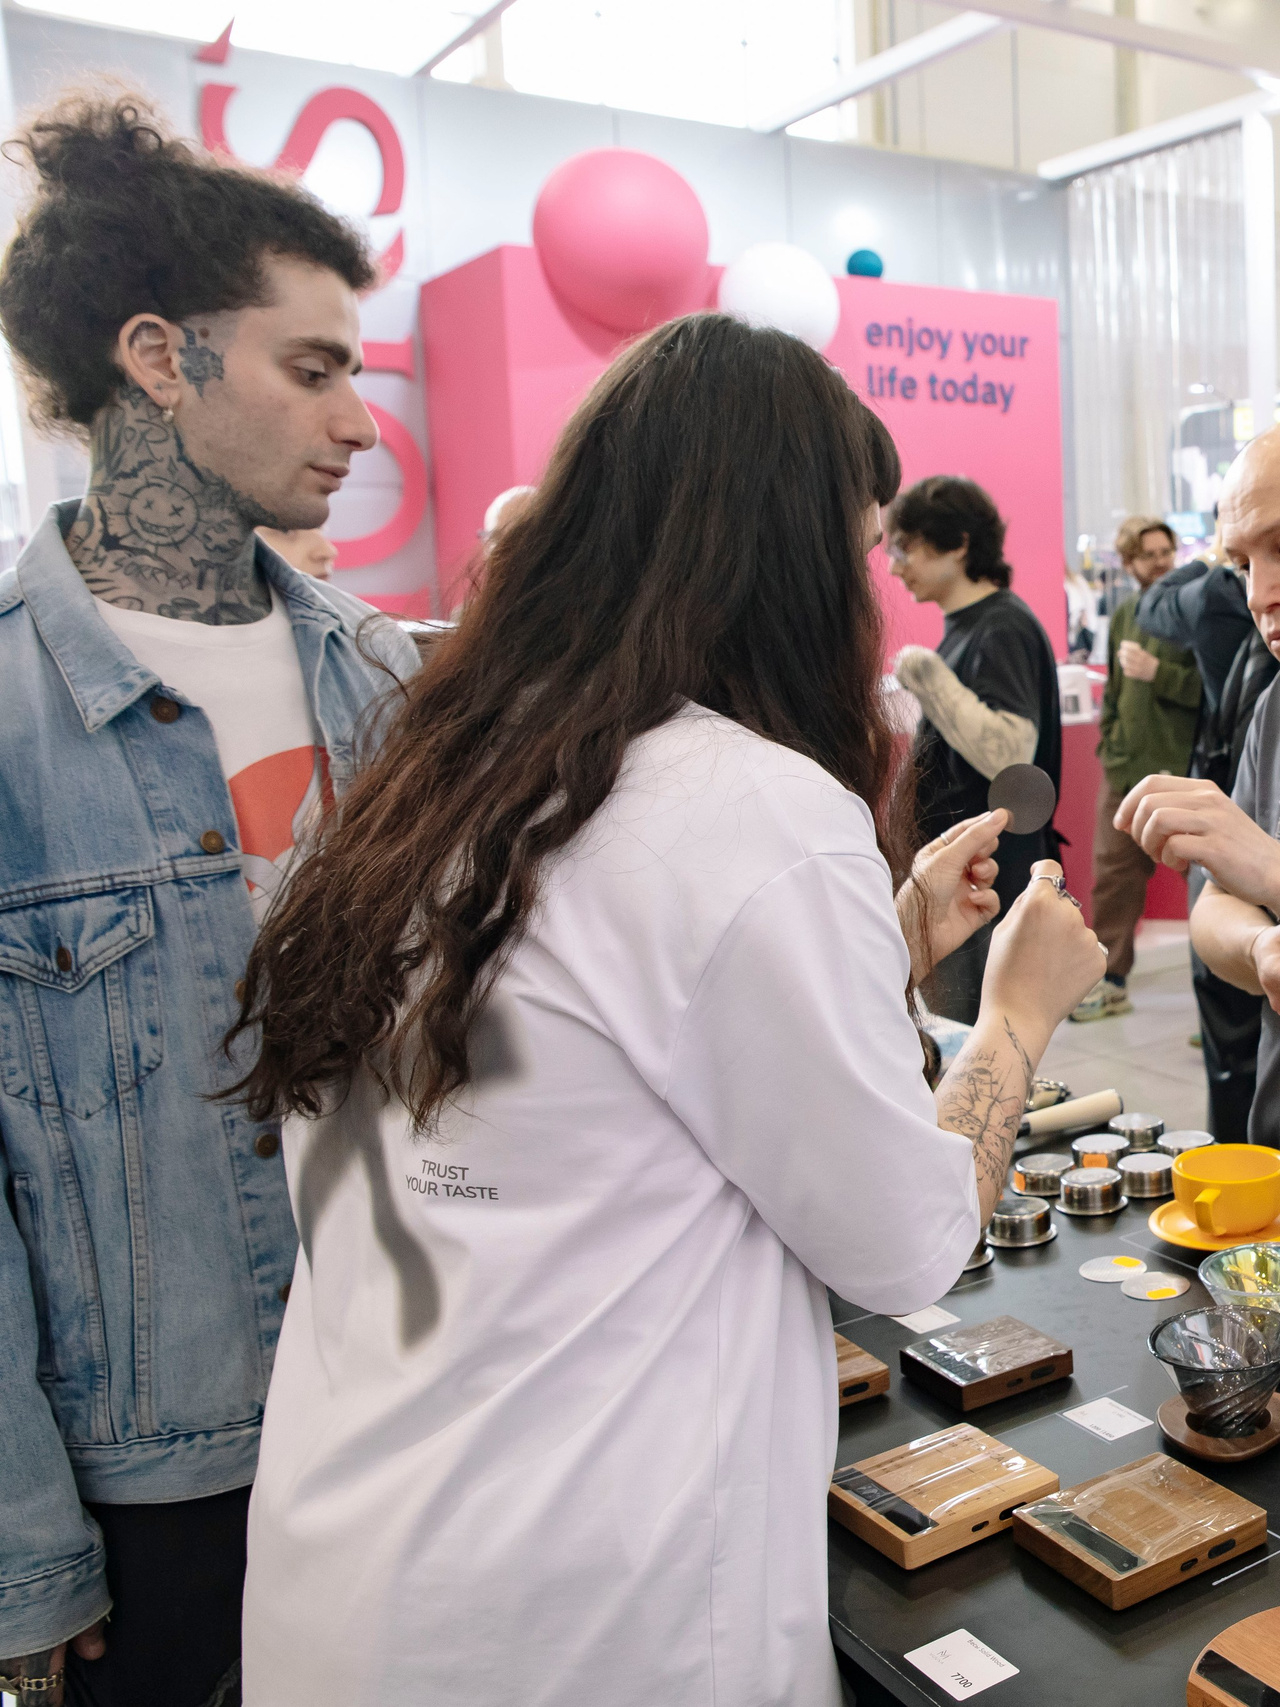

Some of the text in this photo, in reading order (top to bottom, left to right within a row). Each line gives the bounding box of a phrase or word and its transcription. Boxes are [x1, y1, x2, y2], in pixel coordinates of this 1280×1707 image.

[866, 317, 1029, 361] enjoy your
[867, 365, 1015, 413] life today
[422, 1159, 469, 1181] TRUST
[405, 1174, 499, 1200] YOUR TASTE
[979, 1646, 992, 1659] Solid
[990, 1654, 1006, 1668] Wood
[950, 1671, 973, 1689] 7700
